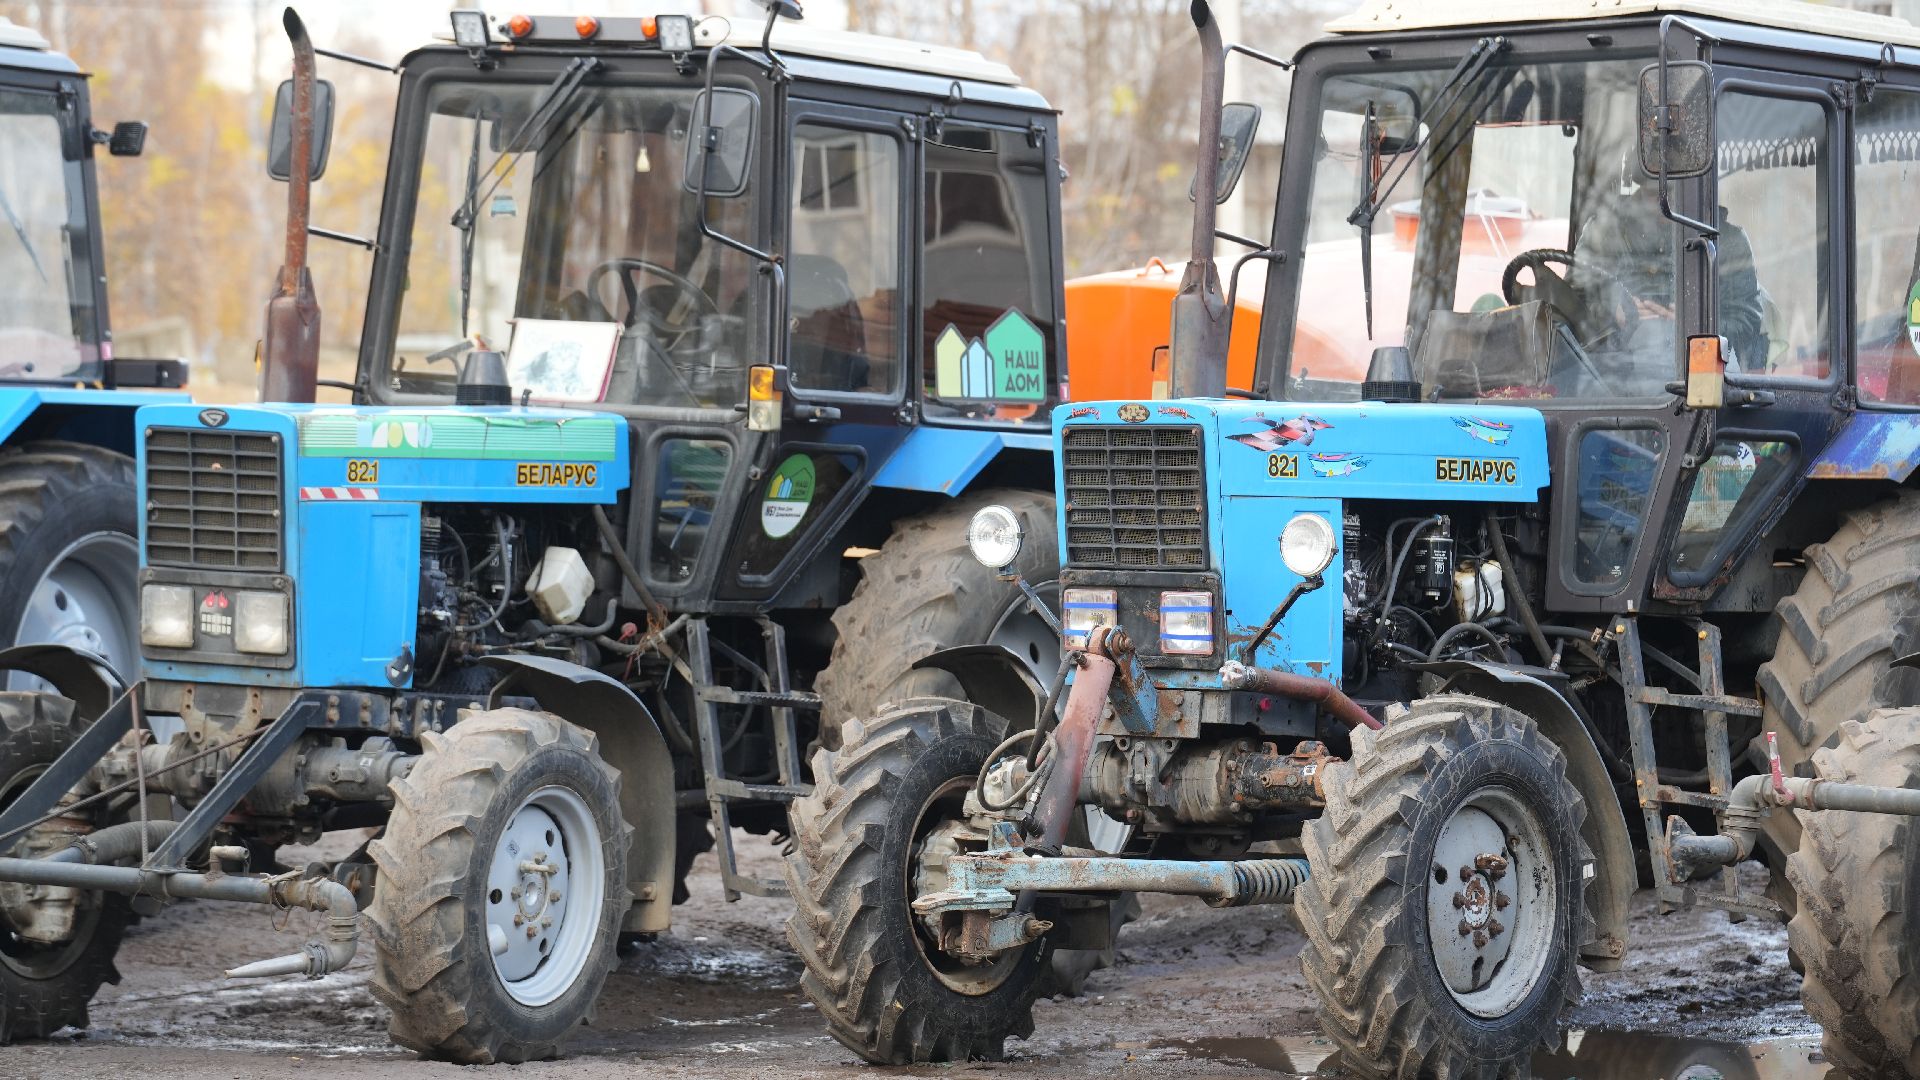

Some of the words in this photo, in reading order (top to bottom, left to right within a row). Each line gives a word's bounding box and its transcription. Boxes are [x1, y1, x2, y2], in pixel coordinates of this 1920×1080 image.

[1004, 350, 1039, 370] НАШ
[1004, 373, 1041, 393] ДОМ
[347, 460, 379, 483] 82.1
[516, 463, 597, 486] БЕЛАРУС
[1267, 453, 1299, 478] 82.1
[1435, 457, 1517, 484] БЕЛАРУС
